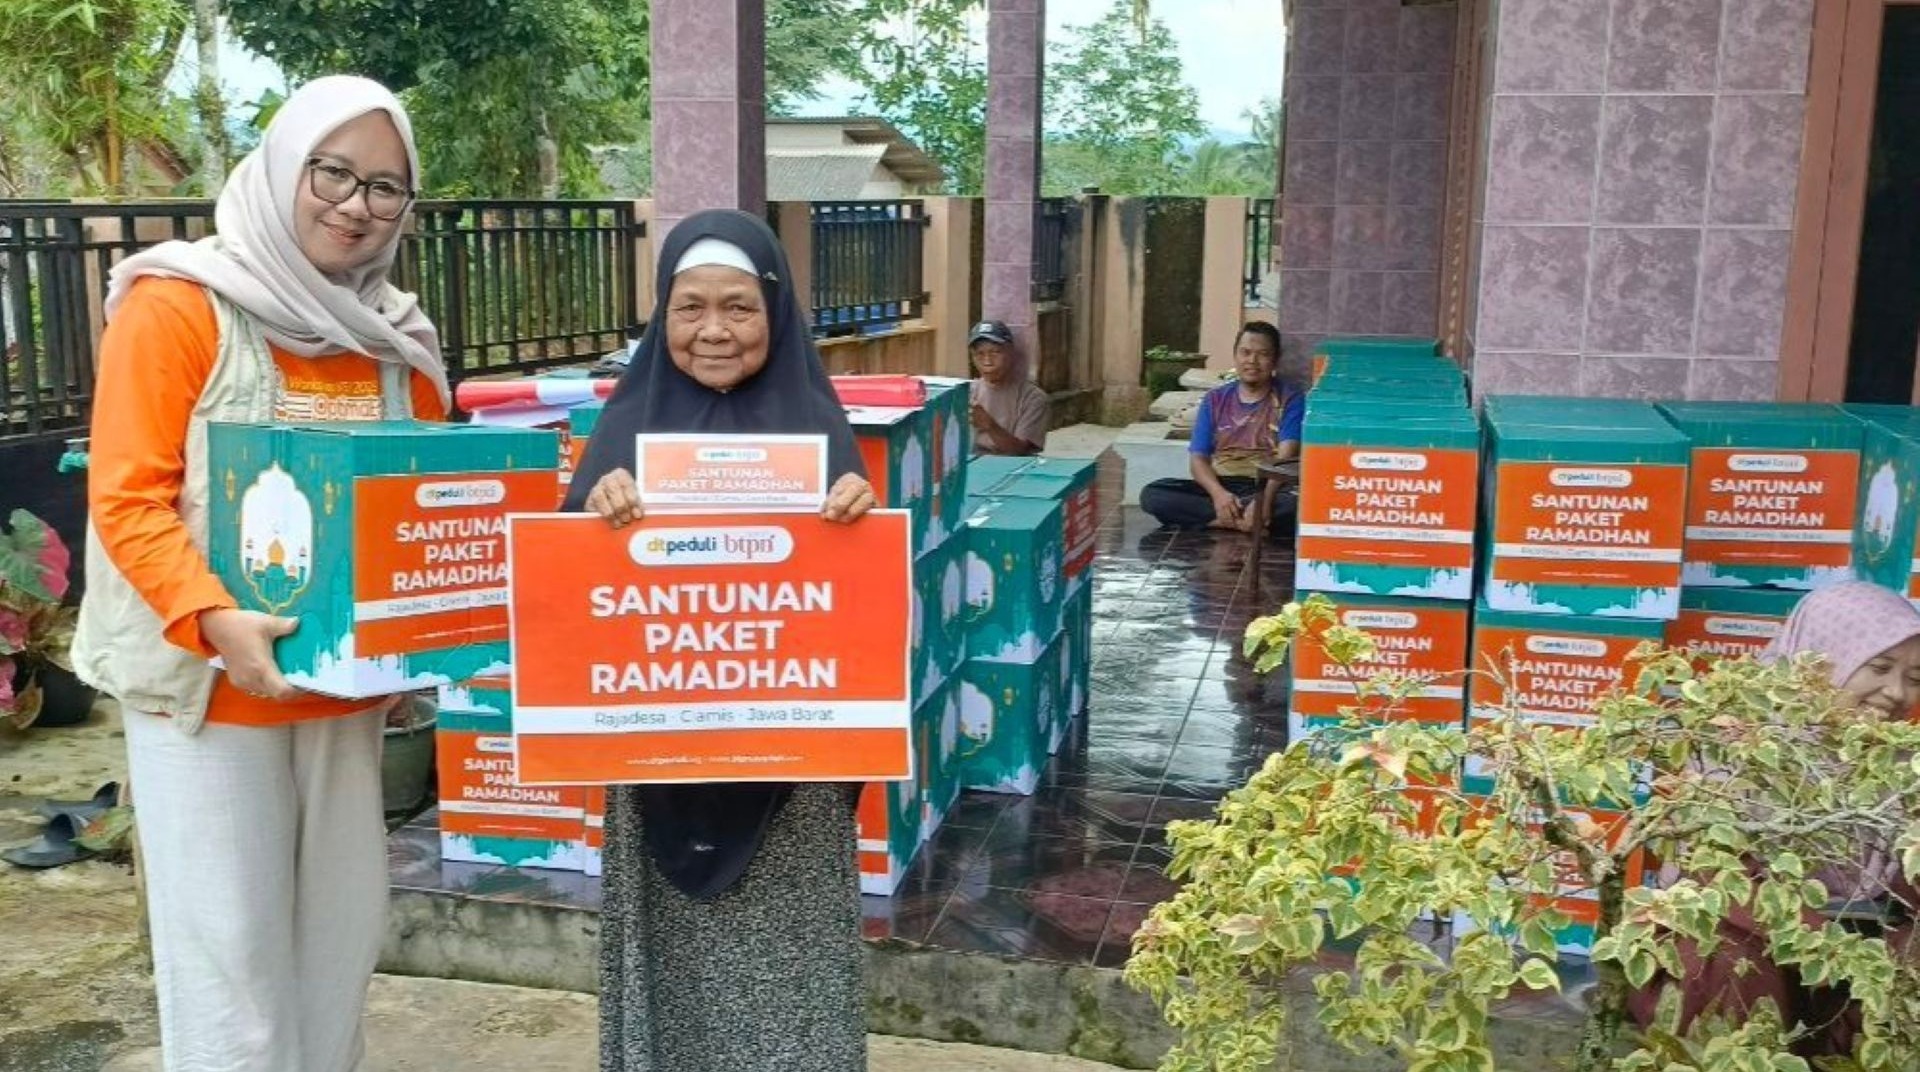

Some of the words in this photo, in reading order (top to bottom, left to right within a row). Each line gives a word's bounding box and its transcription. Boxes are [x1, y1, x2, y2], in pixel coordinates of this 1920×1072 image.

[688, 467, 775, 479] SANTUNAN
[658, 479, 709, 491] PAKET
[712, 479, 804, 491] RAMADHAN
[1334, 475, 1442, 494] SANTUNAN
[1710, 478, 1824, 495] SANTUNAN
[1355, 493, 1420, 509] PAKET
[1531, 493, 1648, 511] SANTUNAN
[1733, 494, 1799, 510] PAKET
[1329, 508, 1444, 526] RAMADHAN
[1555, 511, 1624, 527] PAKET
[1705, 510, 1824, 527] RAMADHAN
[396, 516, 506, 542] SANTUNA
[1526, 527, 1650, 544] RAMADHAN
[424, 539, 498, 565] PAKET
[647, 536, 717, 556] dtpeduli
[392, 562, 508, 592] RAMADHA
[589, 581, 833, 617] SANTUNAN
[644, 619, 784, 653] PAKET
[1359, 652, 1410, 665] AKET
[590, 657, 837, 694] RAMADHAN
[1531, 677, 1598, 694] PAKET
[595, 711, 667, 728] Rajadesa
[747, 707, 786, 721] Jawa
[791, 707, 836, 721] Barat
[463, 758, 515, 771] SANTU
[484, 773, 517, 785] PAK
[463, 785, 560, 803] RAMADHAN
